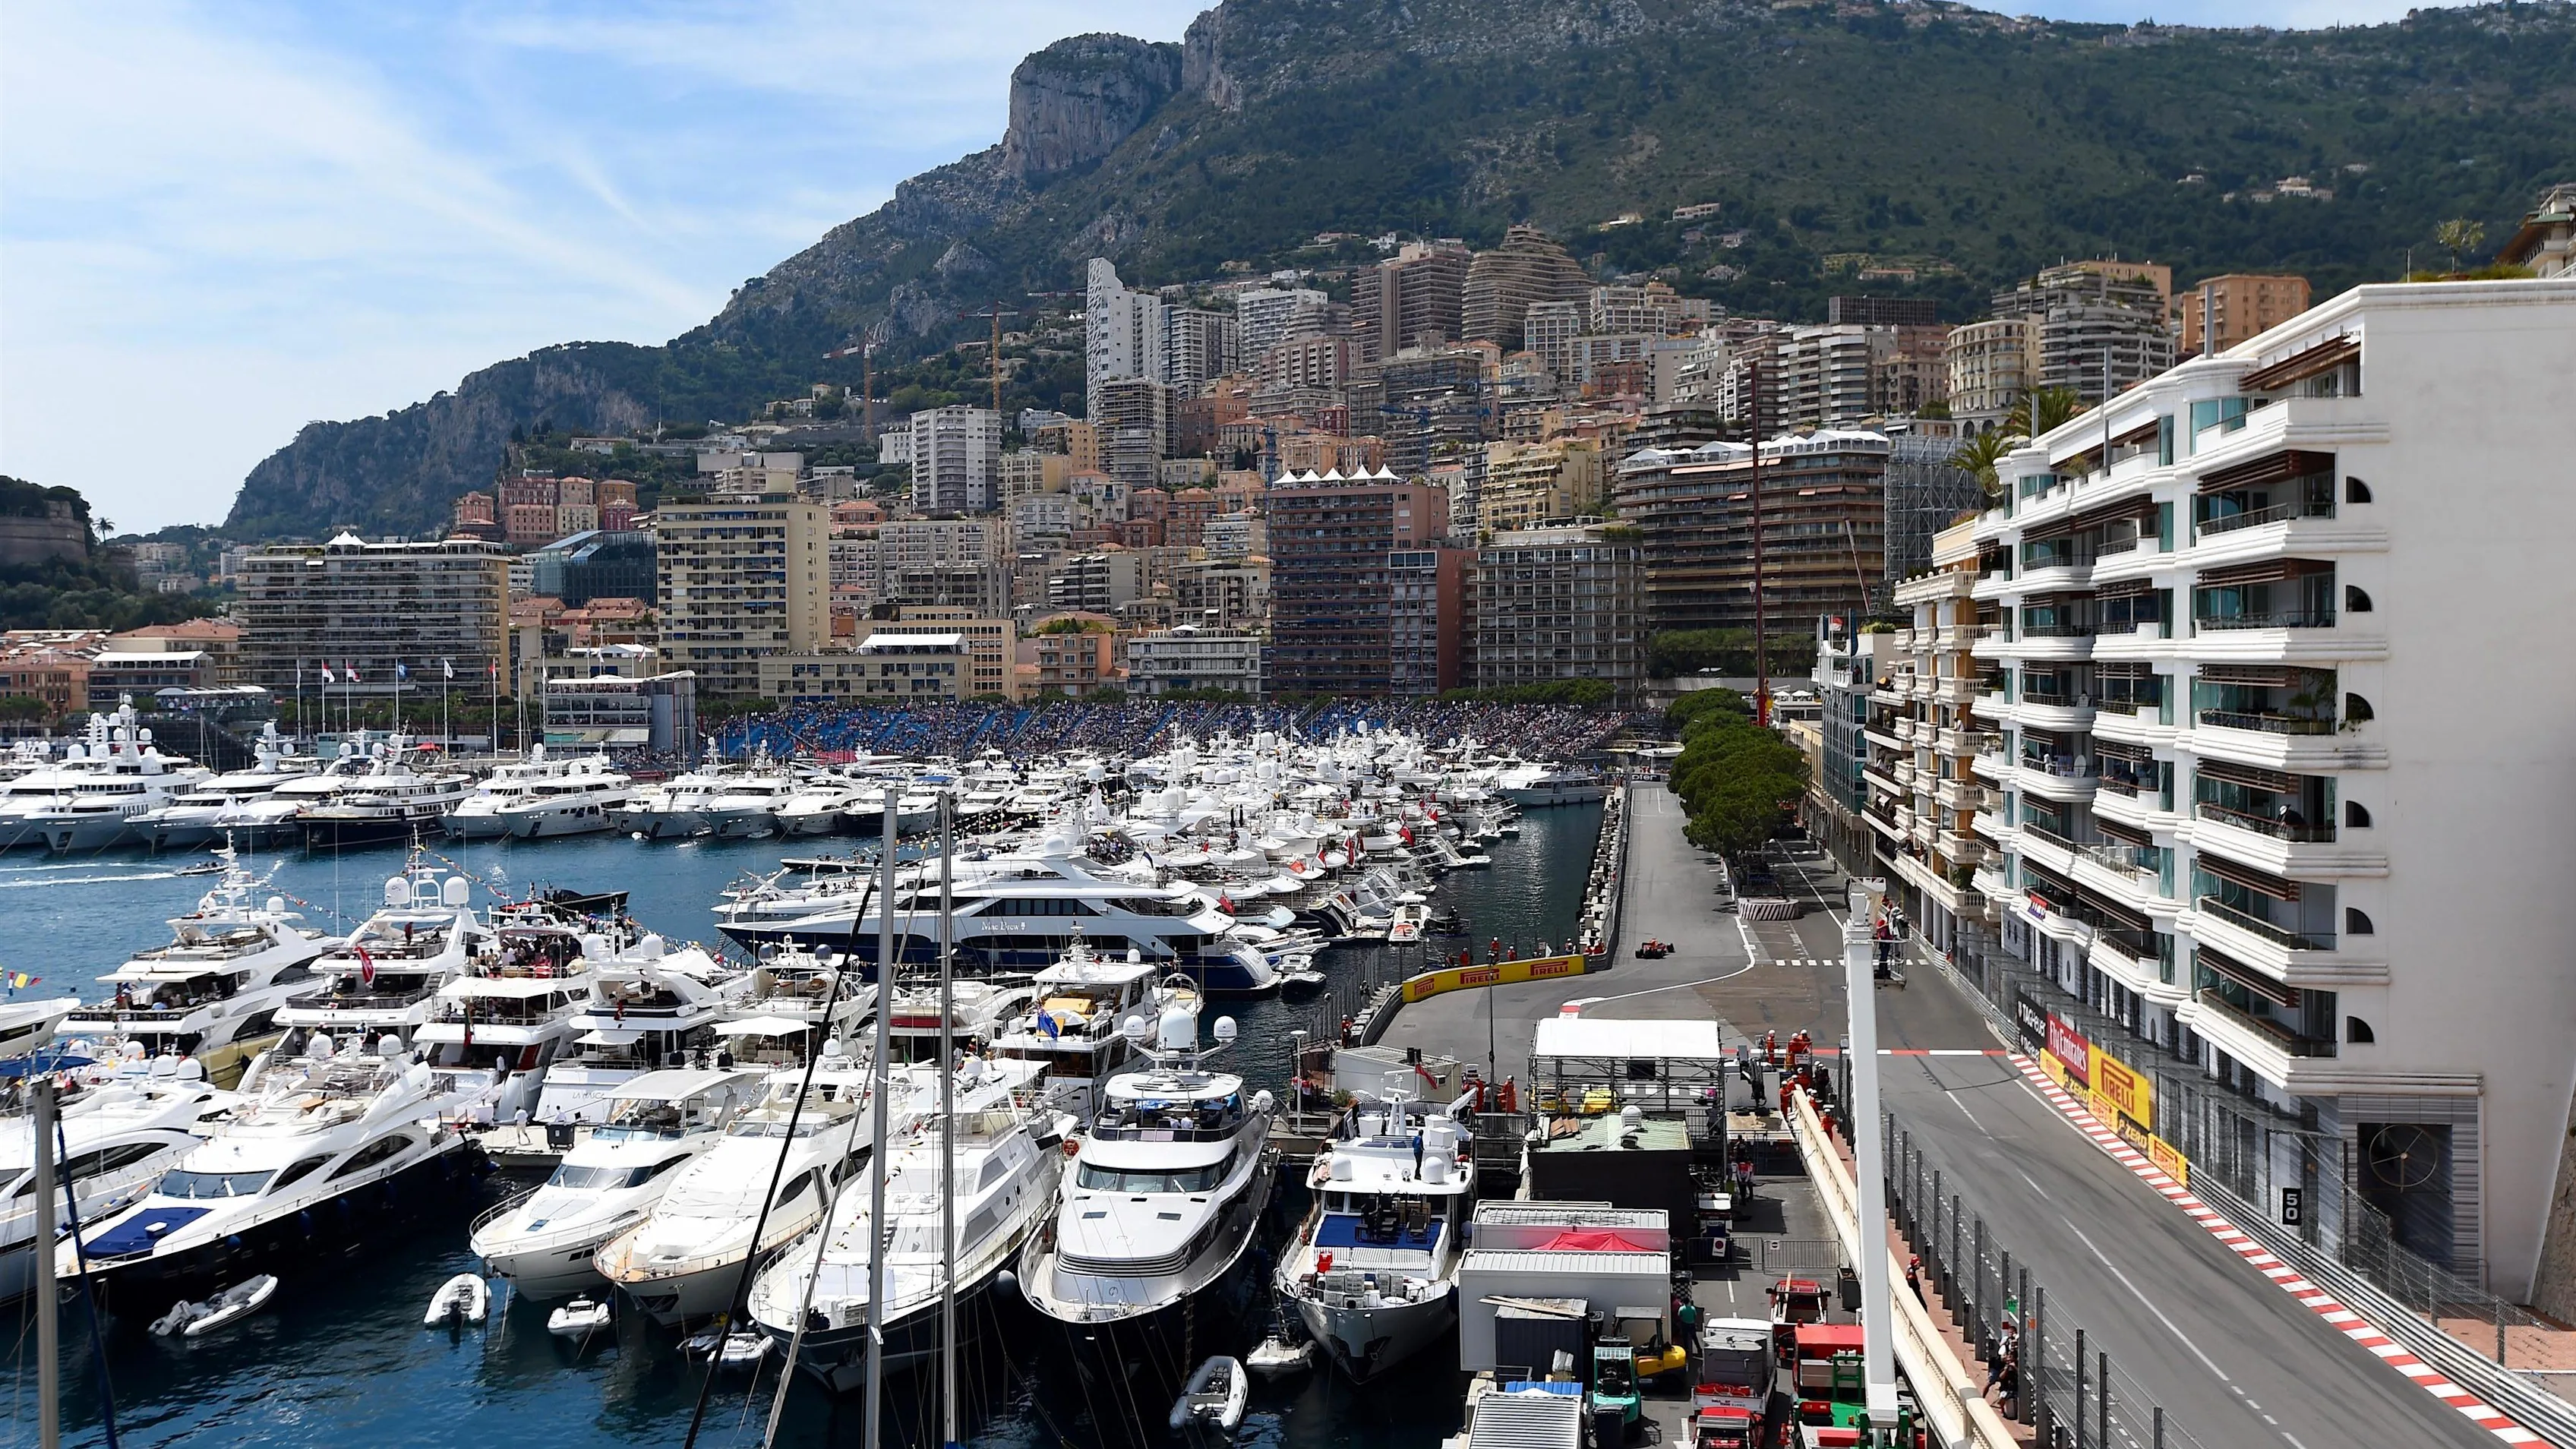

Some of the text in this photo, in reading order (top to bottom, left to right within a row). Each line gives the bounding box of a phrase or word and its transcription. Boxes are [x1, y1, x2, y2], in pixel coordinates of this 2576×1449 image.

[1460, 968, 1500, 985] PIRELLI
[1530, 961, 1569, 977] PIRELLI
[1414, 977, 1435, 996] PIRELLI
[2050, 1020, 2060, 1056] Fly
[2059, 1028, 2087, 1073] Emirates
[2101, 1056, 2135, 1115] PIRELLI
[2125, 1122, 2147, 1150] ZERO
[2286, 1193, 2298, 1220] 50
